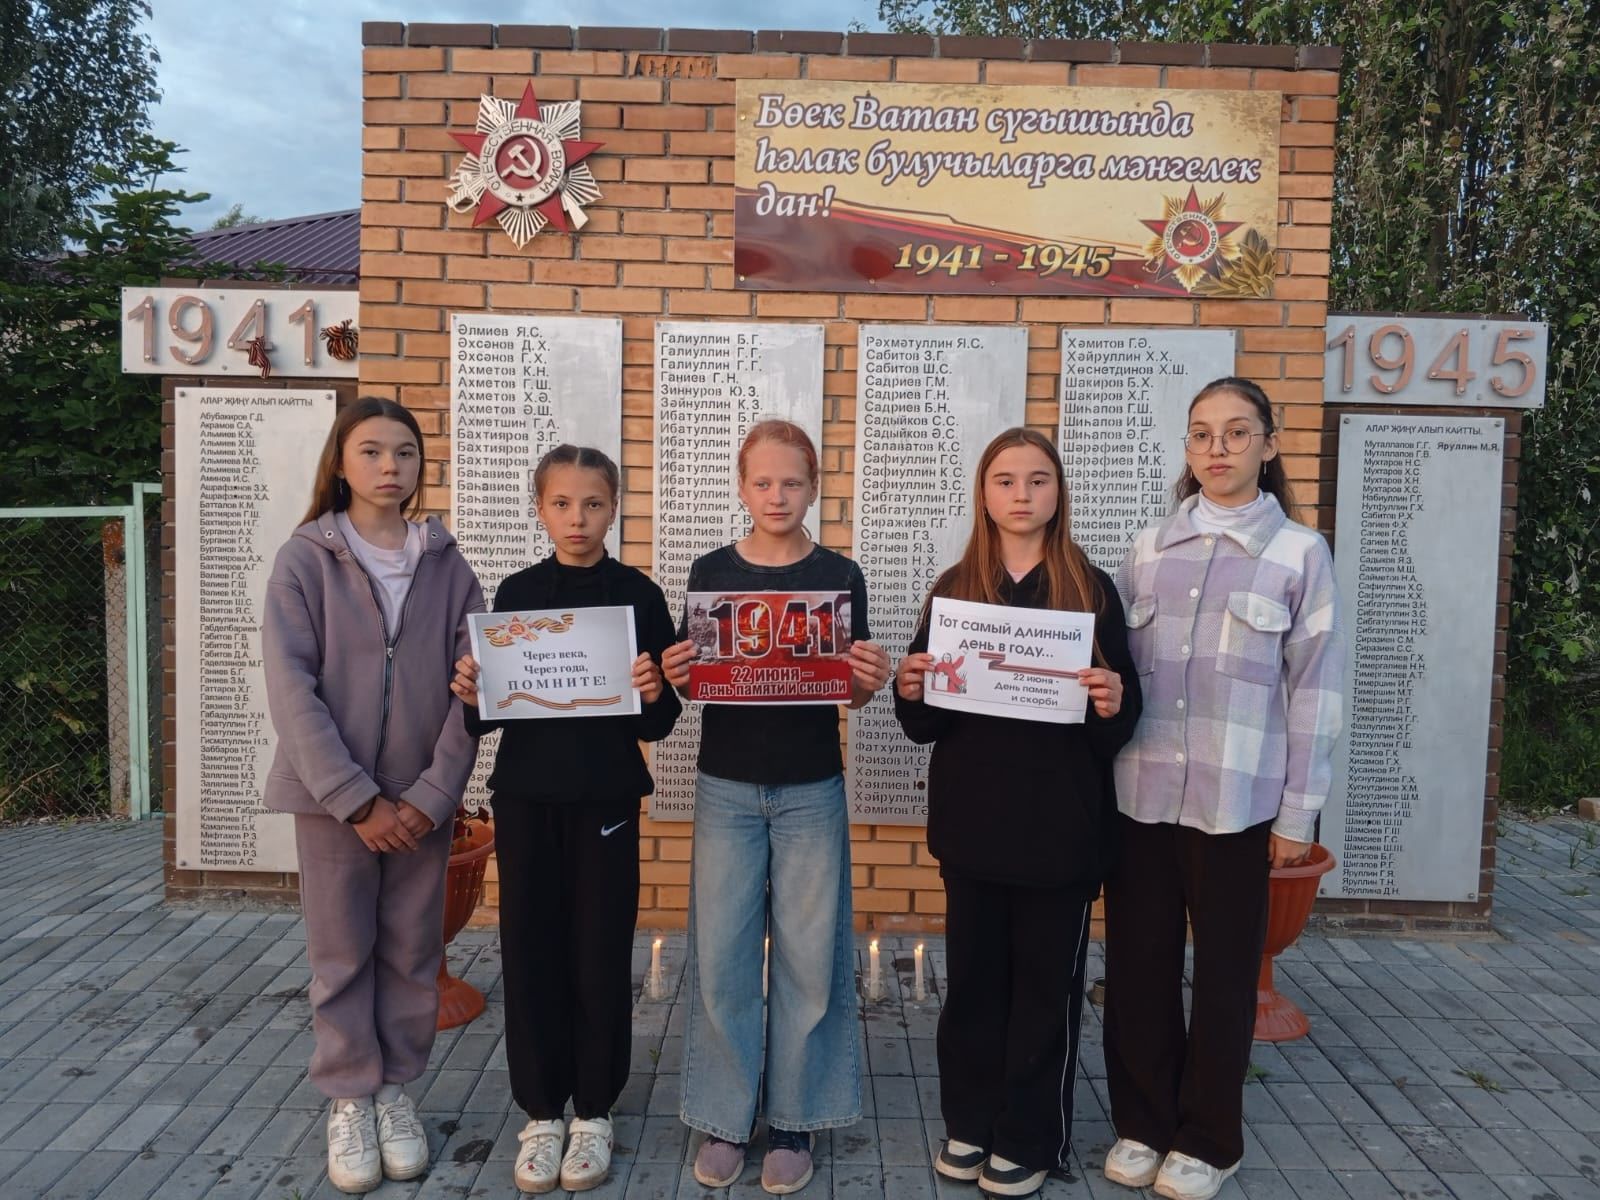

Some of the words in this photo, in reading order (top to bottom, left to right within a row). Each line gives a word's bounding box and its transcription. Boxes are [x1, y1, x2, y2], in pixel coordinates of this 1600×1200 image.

[755, 95, 846, 129] Бөек
[850, 96, 977, 133] Ватан
[985, 101, 1194, 142] сүгышында
[755, 136, 857, 173] һәлак
[865, 142, 1094, 189] булучыларга
[755, 186, 834, 219] дан!
[894, 243, 983, 276] 1941
[1017, 244, 1115, 278] 1945
[127, 295, 314, 367] 1941
[516, 327, 543, 338] Я.С.
[661, 332, 730, 345] Галиуллин
[738, 334, 762, 345] Б.Г.
[957, 338, 984, 349] Я.С.
[521, 353, 547, 364] Г.Х.
[661, 346, 730, 358] Галиуллин
[737, 348, 762, 359] Г.Г.
[866, 350, 919, 361] Сабитов
[1146, 351, 1173, 362] Х.Х.
[661, 358, 730, 371] Галиуллин
[737, 361, 762, 372] Г.Г.
[1328, 324, 1536, 397] 1945
[458, 364, 516, 375] Ахметов
[523, 366, 549, 377] К.Н.
[866, 362, 919, 374] Сабитов
[923, 364, 952, 374] Ш.С.
[1159, 365, 1189, 375] Х.Ш.
[458, 377, 516, 389] Ахметов
[523, 379, 551, 390] Г.Ш.
[661, 372, 705, 383] Ганиев
[713, 373, 739, 384] Г.Н.
[865, 376, 921, 388] Садриев
[926, 377, 949, 388] Г.М.
[1066, 377, 1123, 389] Шакиров
[1127, 377, 1154, 388] Б.Х.
[458, 390, 516, 401] Ахметов
[661, 385, 722, 398] Зиннуров
[730, 386, 759, 398] Ю.З.
[865, 389, 920, 401] Садриев
[925, 390, 950, 400] Г.Н.
[1065, 390, 1123, 402] Шакиров
[1128, 391, 1150, 401] Х.Г.
[200, 397, 223, 406] АЛАР
[738, 400, 763, 411] К.З.
[865, 401, 920, 413] Садриев
[924, 403, 951, 413] Б.Н.
[458, 403, 516, 415] Ахметов
[1127, 403, 1153, 414] Г.Ш.
[200, 412, 248, 422] Абубакиров
[458, 416, 527, 428] Ахметшин
[533, 418, 560, 429] Г.А.
[660, 411, 731, 423] Ибатуллин
[864, 415, 928, 427] Садыйков
[932, 416, 959, 427] С.С.
[1126, 417, 1156, 427] И.Ш.
[200, 421, 235, 430] Акрамов
[1366, 425, 1389, 433] АЛАР
[1417, 426, 1444, 434] АЛЫП
[457, 429, 529, 441] Бахтияров
[536, 431, 560, 442] З.Г.
[863, 440, 933, 452] Салаватов
[1138, 443, 1166, 453] С.К.
[1437, 442, 1478, 451] Яруллин
[863, 453, 936, 467] Сафиуллин
[1138, 456, 1166, 466] М.К.
[862, 492, 945, 504] Сибгатуллин
[949, 493, 967, 503] Г.Г.
[200, 501, 237, 510] Батталов
[659, 514, 723, 525] Камалиев
[861, 517, 927, 530] Сиражиев
[930, 518, 948, 529] Г.Г.
[707, 600, 836, 658] 1941
[939, 614, 958, 628] Тот
[961, 619, 1011, 635] самый
[1014, 627, 1081, 642] длинный
[959, 639, 994, 651] день
[999, 643, 1005, 651] в
[1009, 644, 1054, 659] году...
[523, 651, 556, 661] Через
[559, 651, 587, 659] века,
[524, 665, 557, 675] Через
[560, 665, 588, 674] года,
[731, 666, 751, 683] 22
[754, 667, 800, 681] июня
[1013, 673, 1025, 681] 22
[1027, 675, 1053, 684] июня
[698, 682, 733, 697] День
[734, 682, 785, 696] памяти
[785, 681, 797, 695] и
[799, 678, 847, 695] скорби
[994, 682, 1020, 690] День
[1023, 685, 1059, 695] памяти
[1020, 696, 1058, 707] скорби
[200, 806, 234, 815] Ихсанов
